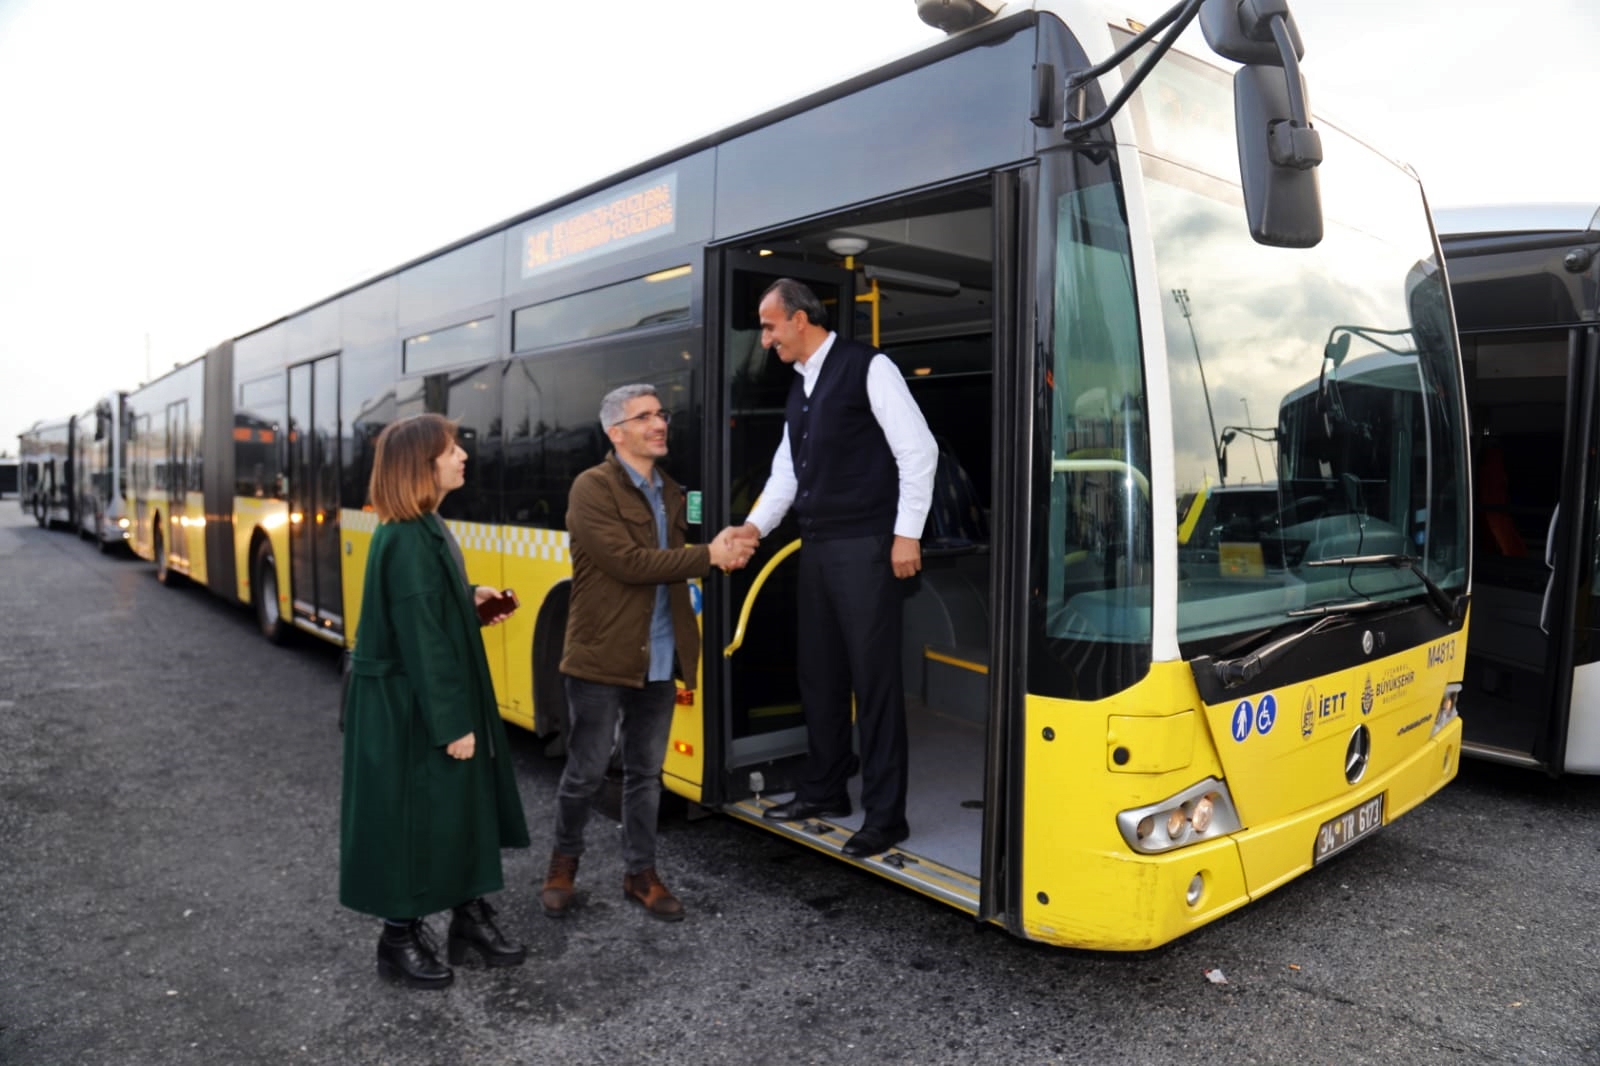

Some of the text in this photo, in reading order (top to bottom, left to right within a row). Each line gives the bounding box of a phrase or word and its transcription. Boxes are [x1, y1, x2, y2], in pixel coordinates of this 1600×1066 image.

[1427, 640, 1455, 668] M4813
[1320, 799, 1379, 853] 34 TR 6173
